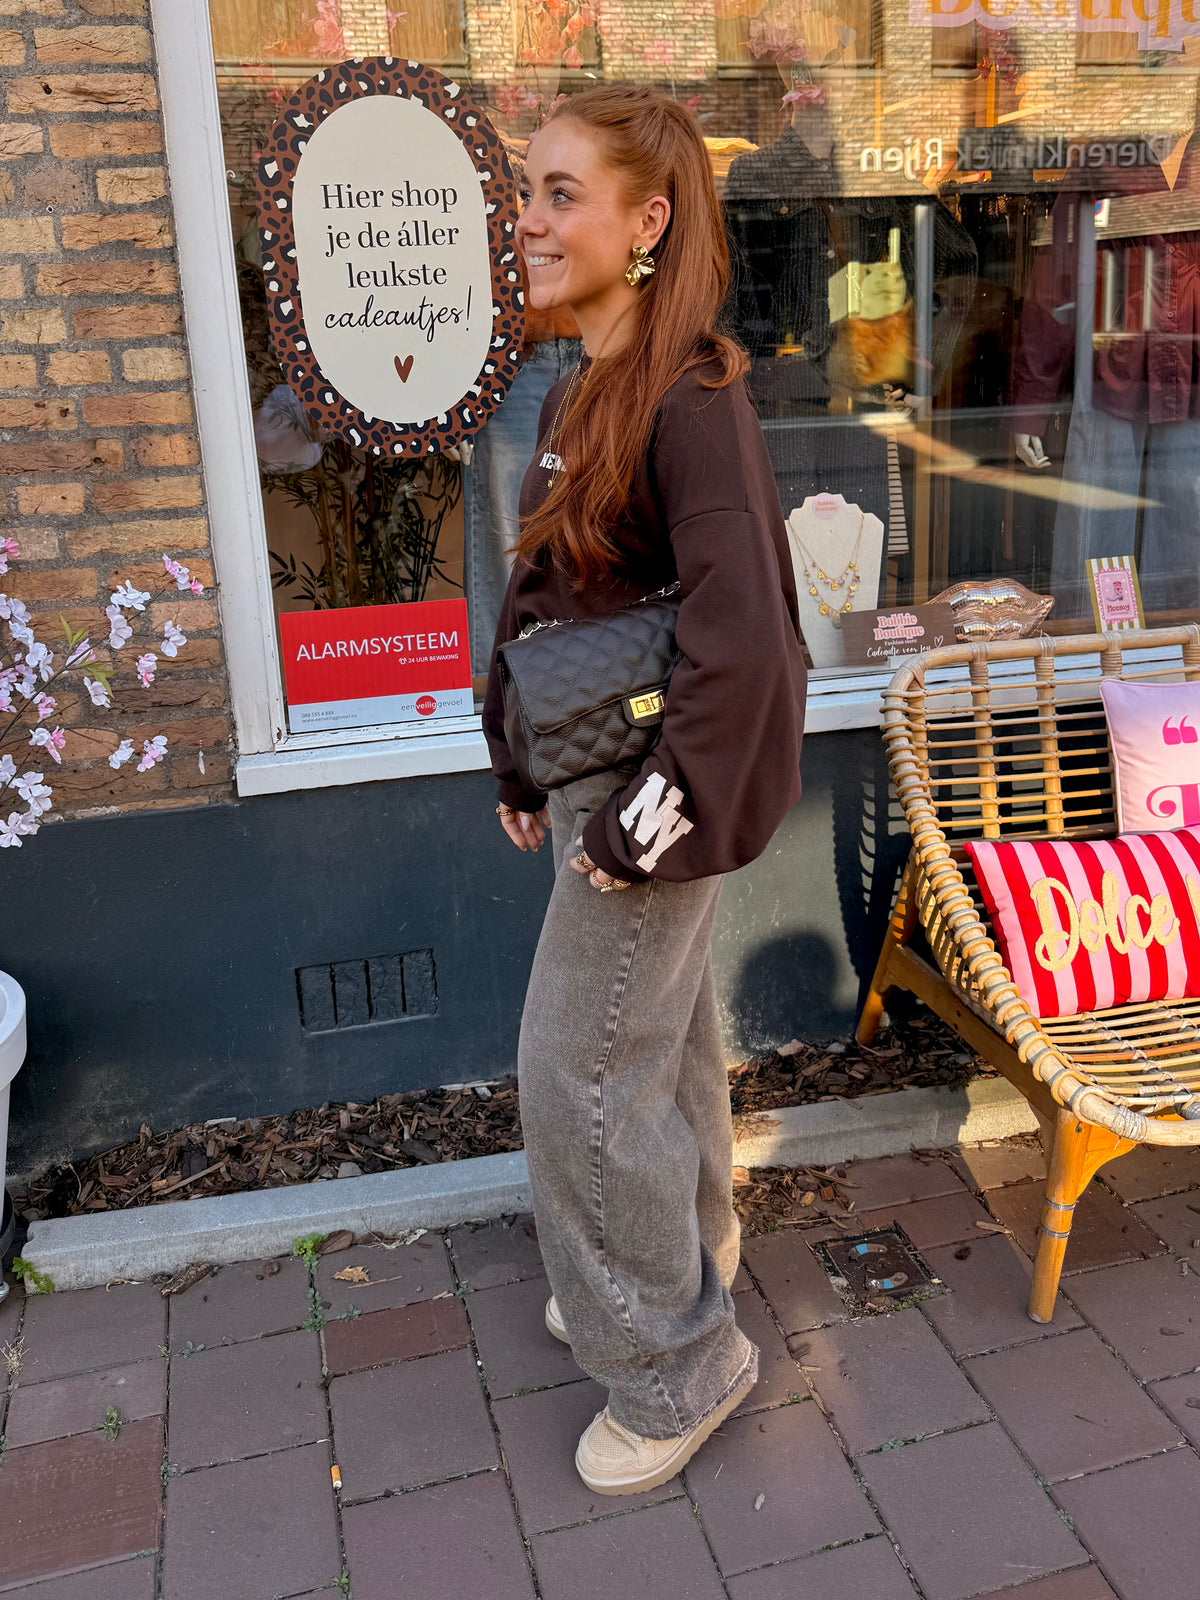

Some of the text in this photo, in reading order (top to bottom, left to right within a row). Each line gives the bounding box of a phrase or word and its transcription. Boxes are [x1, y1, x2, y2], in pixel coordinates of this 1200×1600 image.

[321, 180, 458, 213] Hier shop
[325, 220, 460, 258] je de áller
[346, 261, 448, 289] leukste
[324, 285, 473, 343] cadeautjes!
[874, 626, 924, 640] Boutique
[878, 613, 917, 628] Bobbie
[296, 630, 459, 662] ALARMSYSTEEM
[429, 653, 459, 661] BEWAKING
[1030, 869, 1181, 972] Dolce
